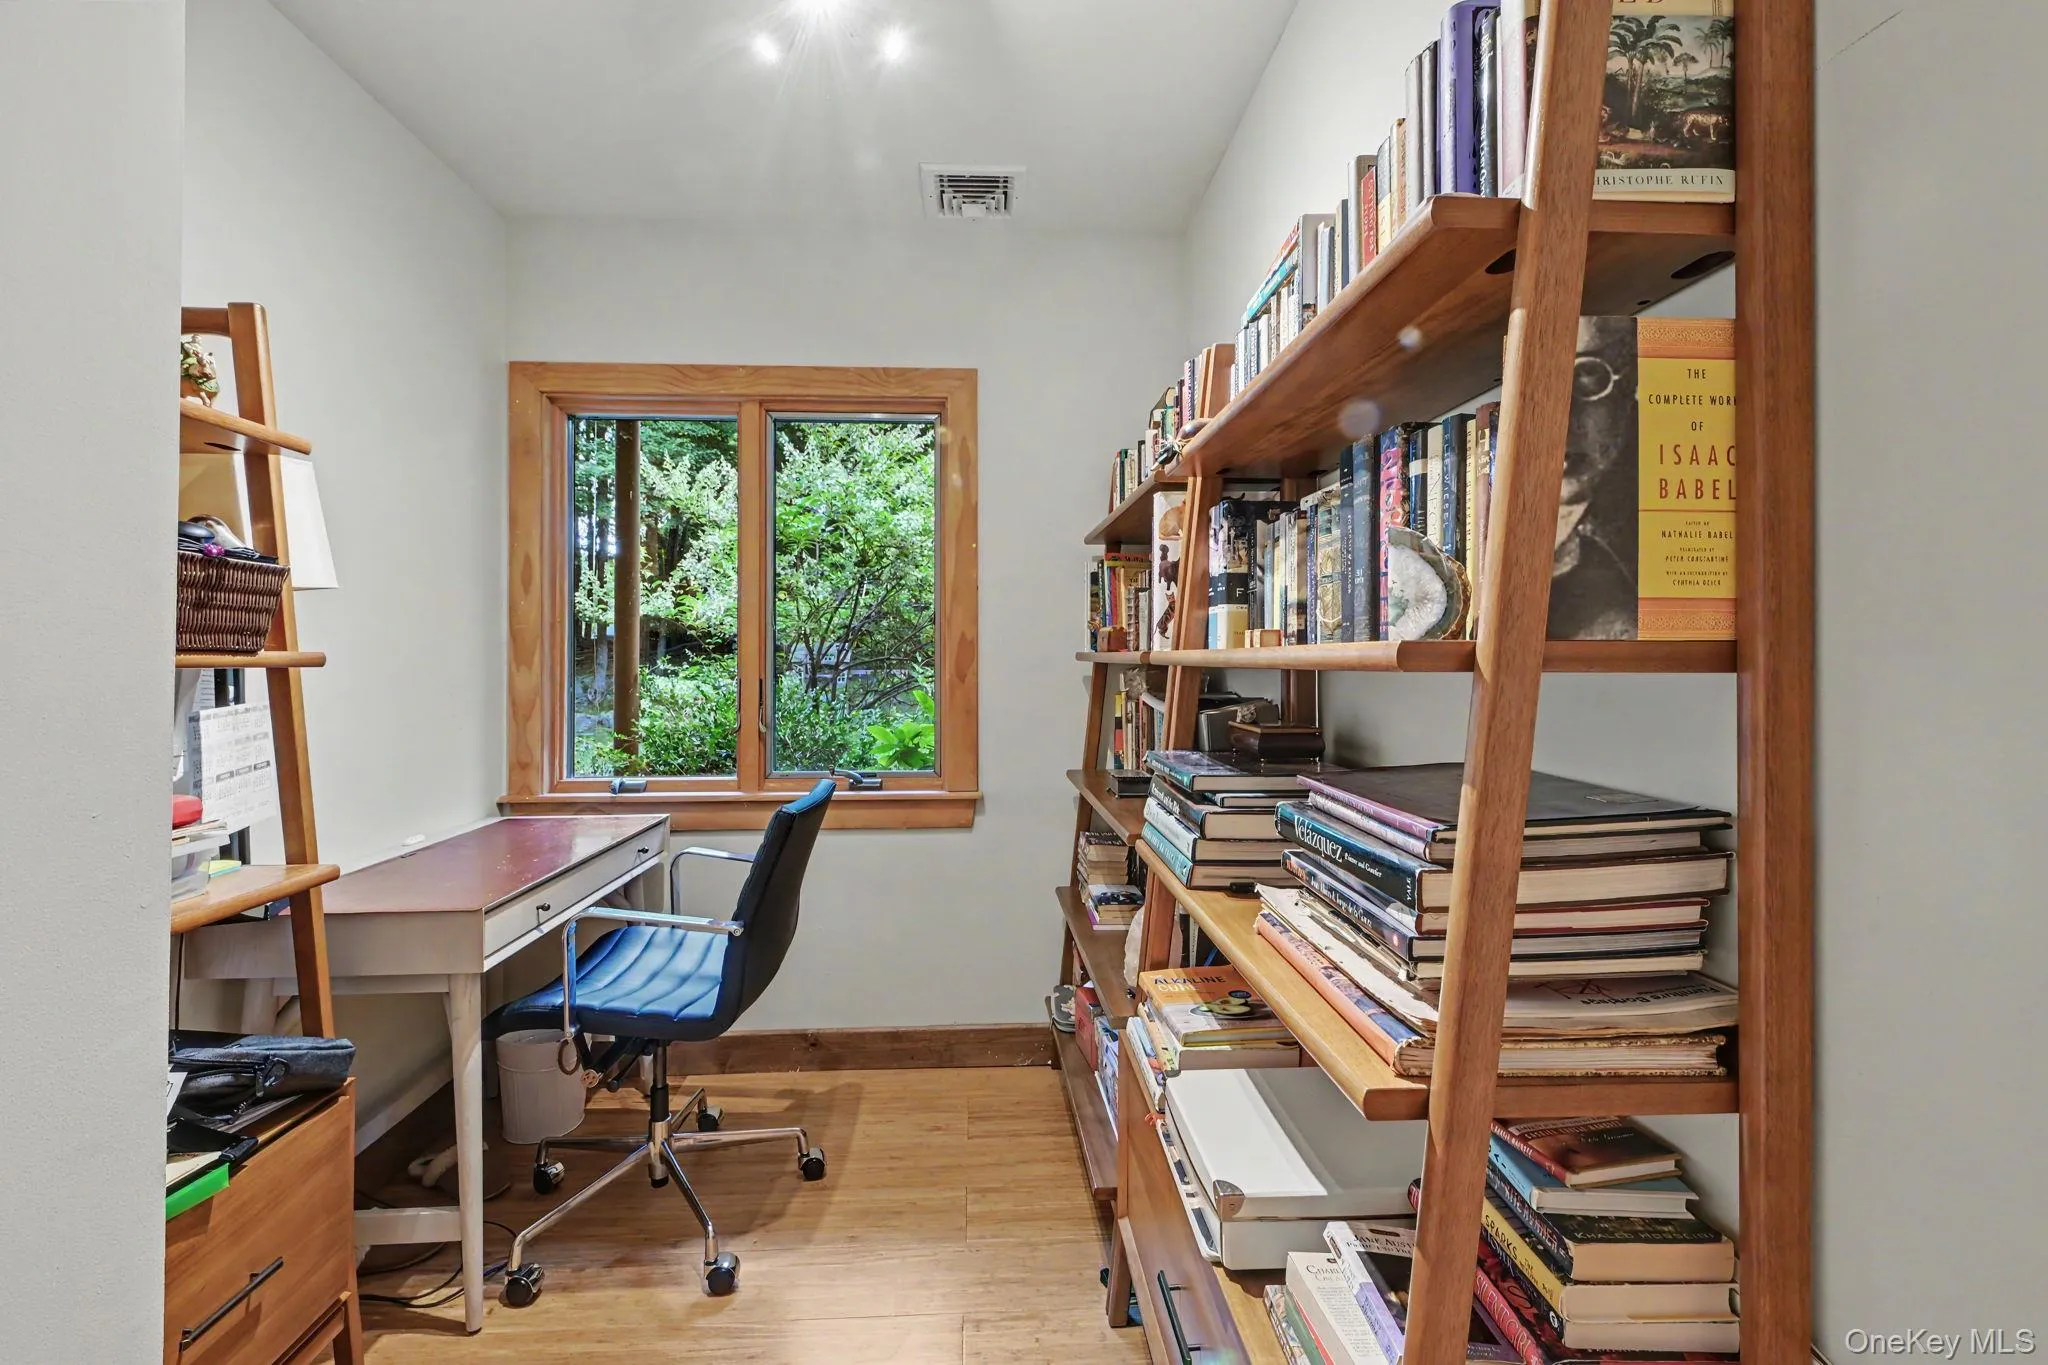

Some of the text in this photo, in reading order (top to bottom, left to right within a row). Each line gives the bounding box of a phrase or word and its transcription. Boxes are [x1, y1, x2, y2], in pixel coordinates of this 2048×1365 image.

[1687, 368, 1707, 379] THE
[1648, 394, 1703, 406] COMPLETE
[1691, 421, 1704, 431] OF
[1659, 444, 1736, 466] ISAAC
[1659, 478, 1737, 500] BABEL
[1661, 530, 1733, 539] NATHALIE BABEL
[1294, 815, 1343, 863] Velázquez
[1154, 976, 1226, 985] ALKALINE
[1353, 1234, 1381, 1245] JANE
[1485, 1214, 1518, 1260] SPARKS
[1574, 1232, 1634, 1240] KHALED
[1476, 1274, 1510, 1325] SILENT
[1505, 1319, 1532, 1359] GIRL
